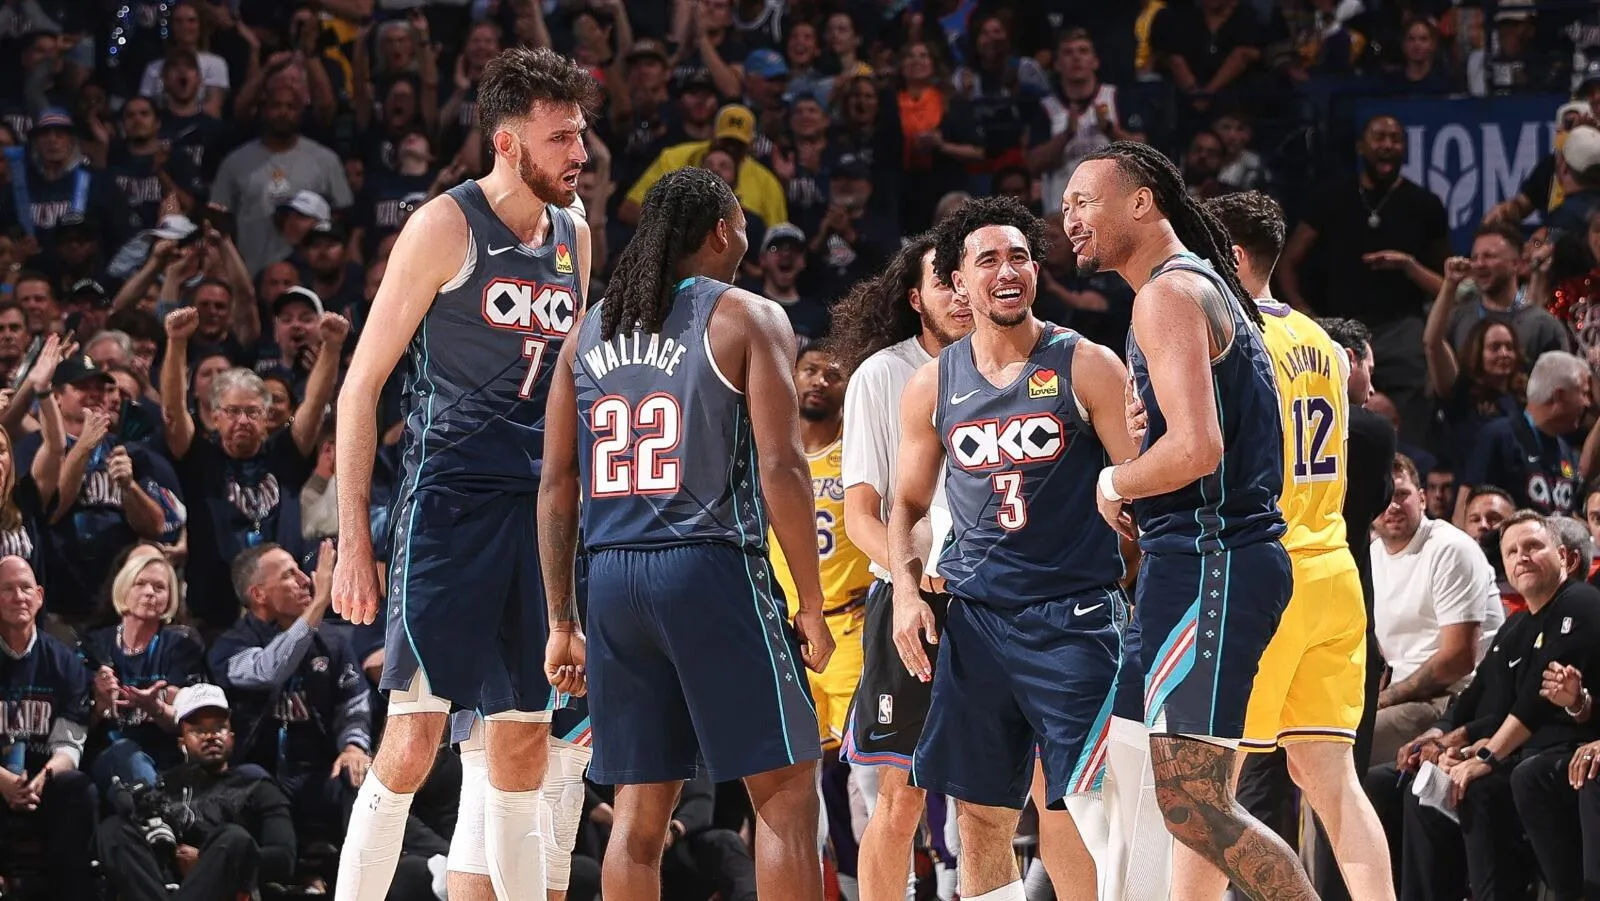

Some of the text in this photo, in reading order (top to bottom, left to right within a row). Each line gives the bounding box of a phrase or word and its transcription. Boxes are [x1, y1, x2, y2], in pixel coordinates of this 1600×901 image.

[482, 277, 576, 337] OKC
[518, 336, 548, 399] 7
[584, 332, 687, 380] WALLACE
[1030, 385, 1057, 396] Love's
[591, 391, 682, 497] 22
[948, 411, 1065, 470] OKC
[1292, 397, 1337, 482] 12
[991, 470, 1027, 530] 3
